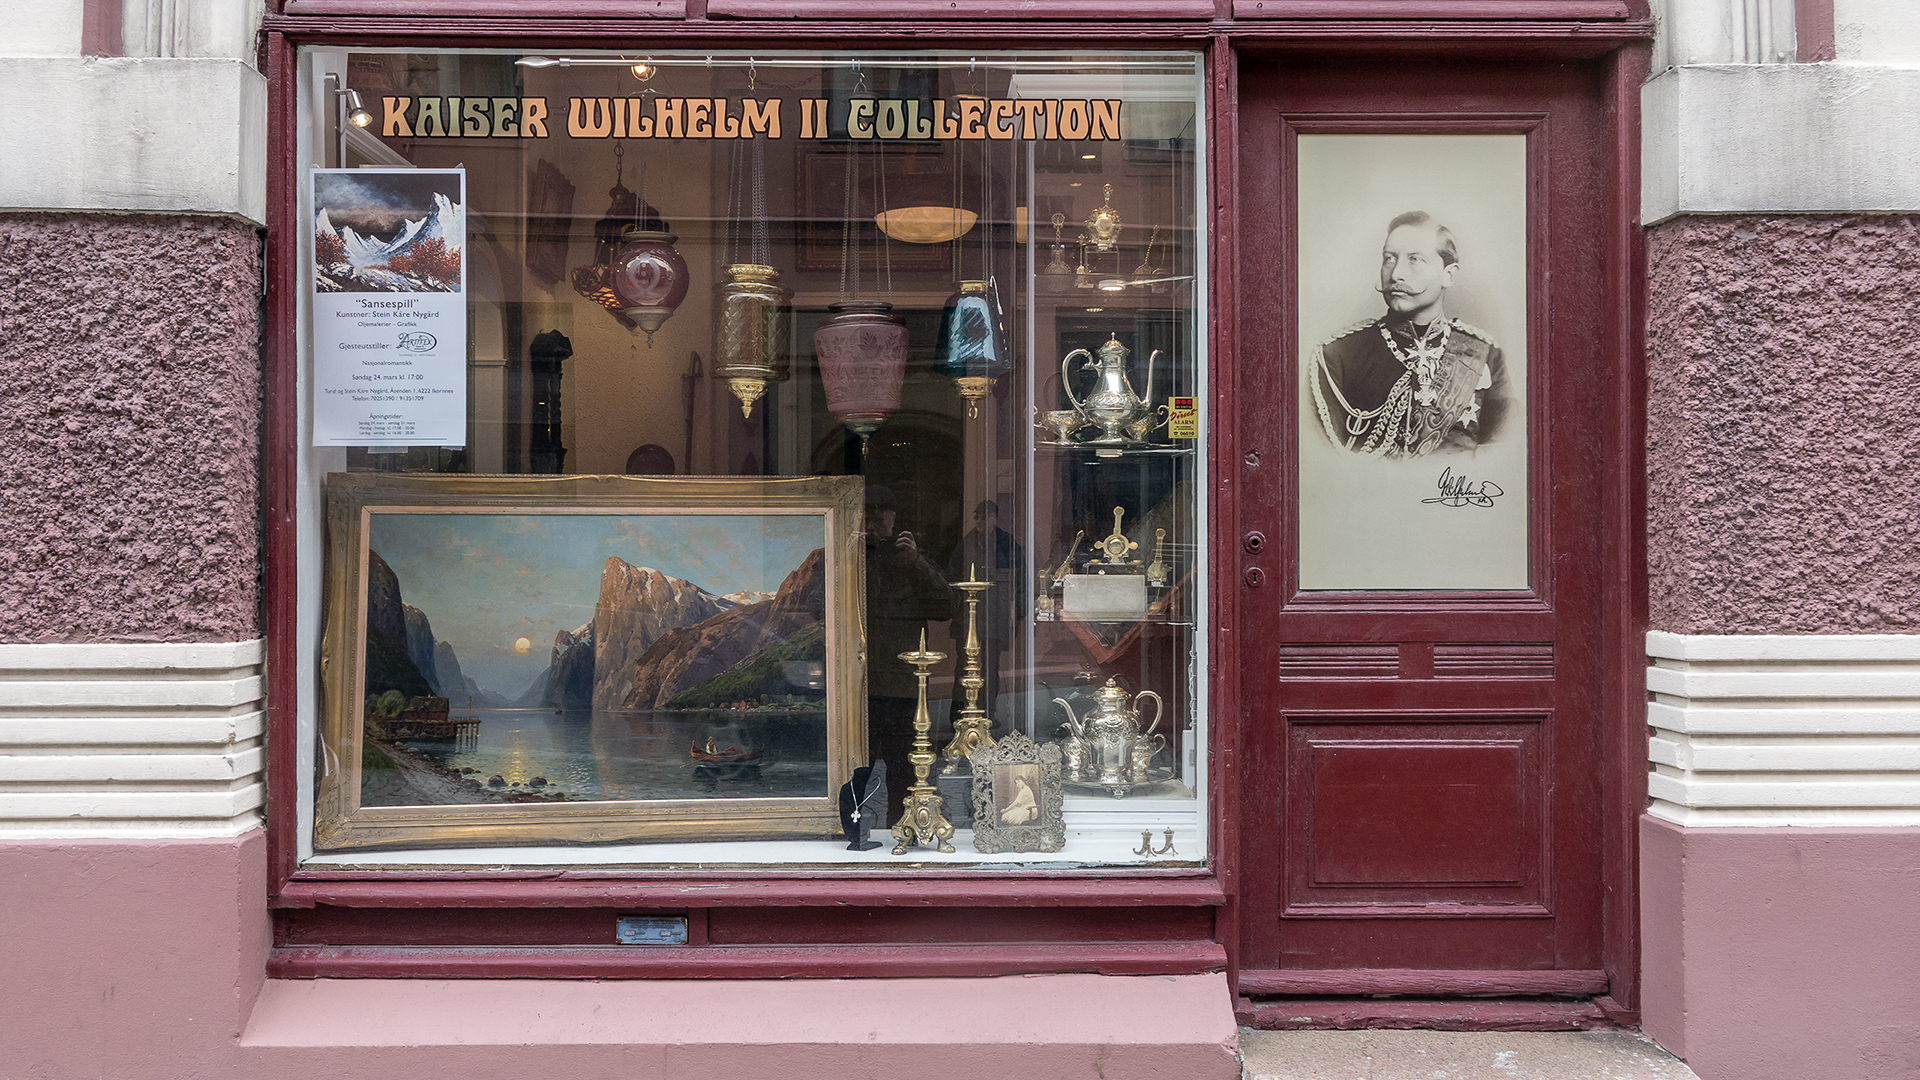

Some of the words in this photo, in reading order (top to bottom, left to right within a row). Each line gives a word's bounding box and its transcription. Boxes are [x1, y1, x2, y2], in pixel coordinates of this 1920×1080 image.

[381, 96, 549, 138] KAISER
[567, 97, 782, 139] WILHELM
[798, 98, 829, 140] II
[847, 98, 1122, 141] COLLECTION
[413, 311, 440, 319] Nygård
[338, 342, 392, 350] Gjesteutstiller:
